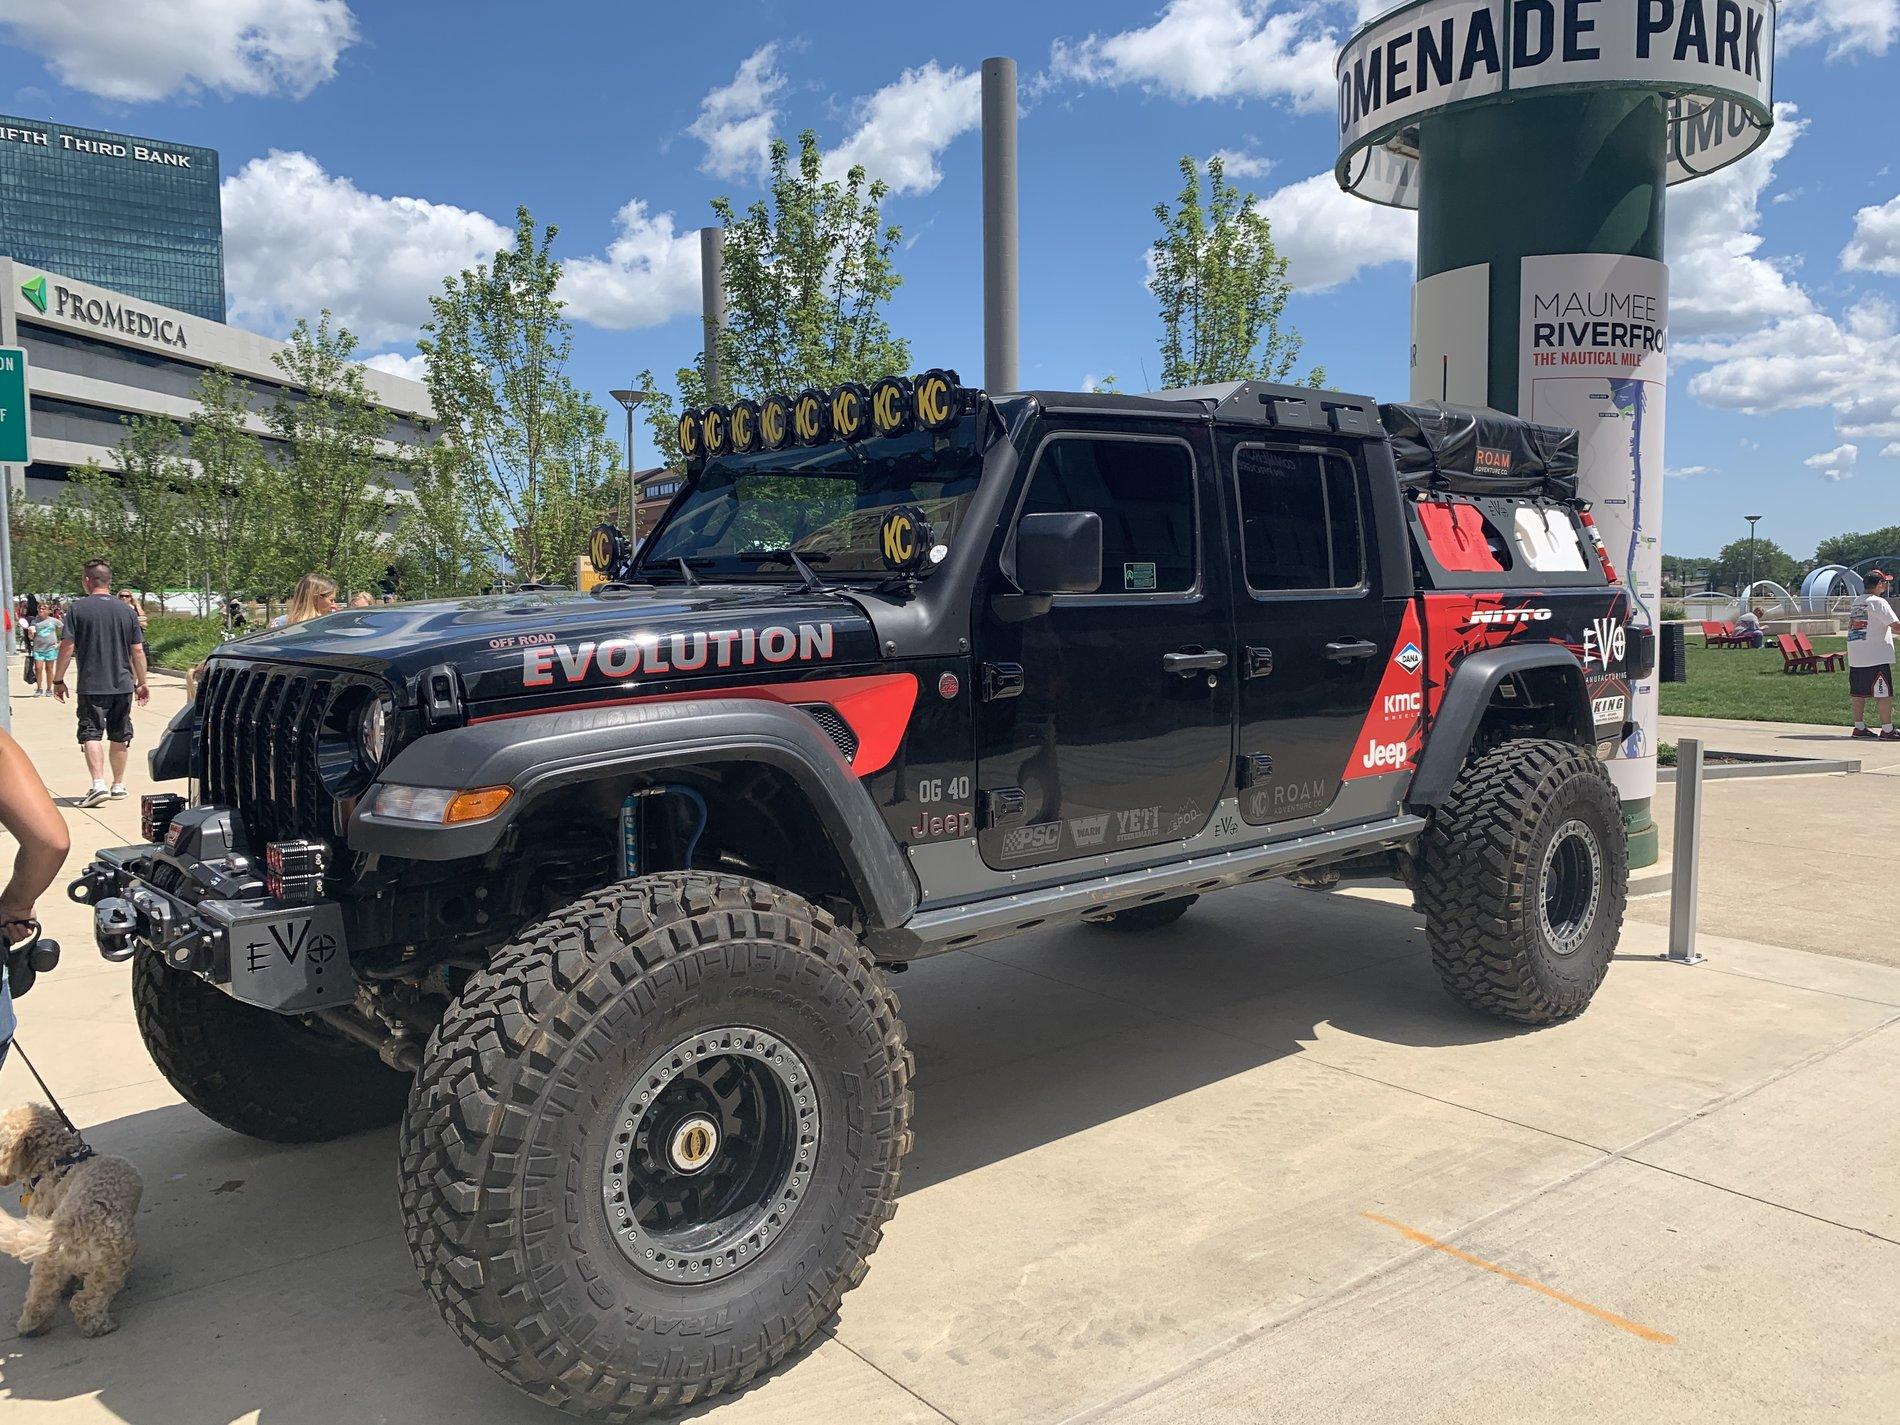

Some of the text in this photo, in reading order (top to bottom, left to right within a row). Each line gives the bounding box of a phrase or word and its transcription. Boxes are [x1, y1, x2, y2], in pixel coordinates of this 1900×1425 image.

[1636, 0, 1764, 82] PARK
[60, 134, 126, 158] THIRD
[134, 146, 191, 168] BANK
[1534, 292, 1656, 322] MAUMEE
[1533, 351, 1642, 367] THE NAUTICAL MILE
[832, 390, 858, 435] KC
[873, 384, 901, 430] KC
[917, 377, 948, 425] KC
[703, 411, 722, 454] KC
[731, 406, 750, 447] KC
[761, 402, 783, 443] KC
[795, 397, 819, 439] KC
[680, 415, 695, 453] KC
[1476, 450, 1510, 467] ROAM
[592, 531, 610, 568] KC
[883, 515, 912, 563] KC
[1470, 608, 1552, 624] NITTO
[489, 633, 556, 650] OFF ROAD
[522, 622, 834, 687] EVOLUTION
[1583, 617, 1627, 671] EVO
[1402, 654, 1419, 663] DANA
[1585, 671, 1627, 682] ANUFACTURING
[1594, 698, 1623, 712] KING
[1363, 739, 1407, 768] Jeep
[948, 776, 969, 799] 40
[1274, 779, 1325, 805] ROAM
[1251, 790, 1267, 817] KC
[1274, 801, 1311, 815] ADVENTURE
[911, 812, 974, 838] Jeep
[1020, 823, 1059, 847] PSC
[1116, 806, 1160, 834] YETI
[246, 919, 336, 974] EVO
